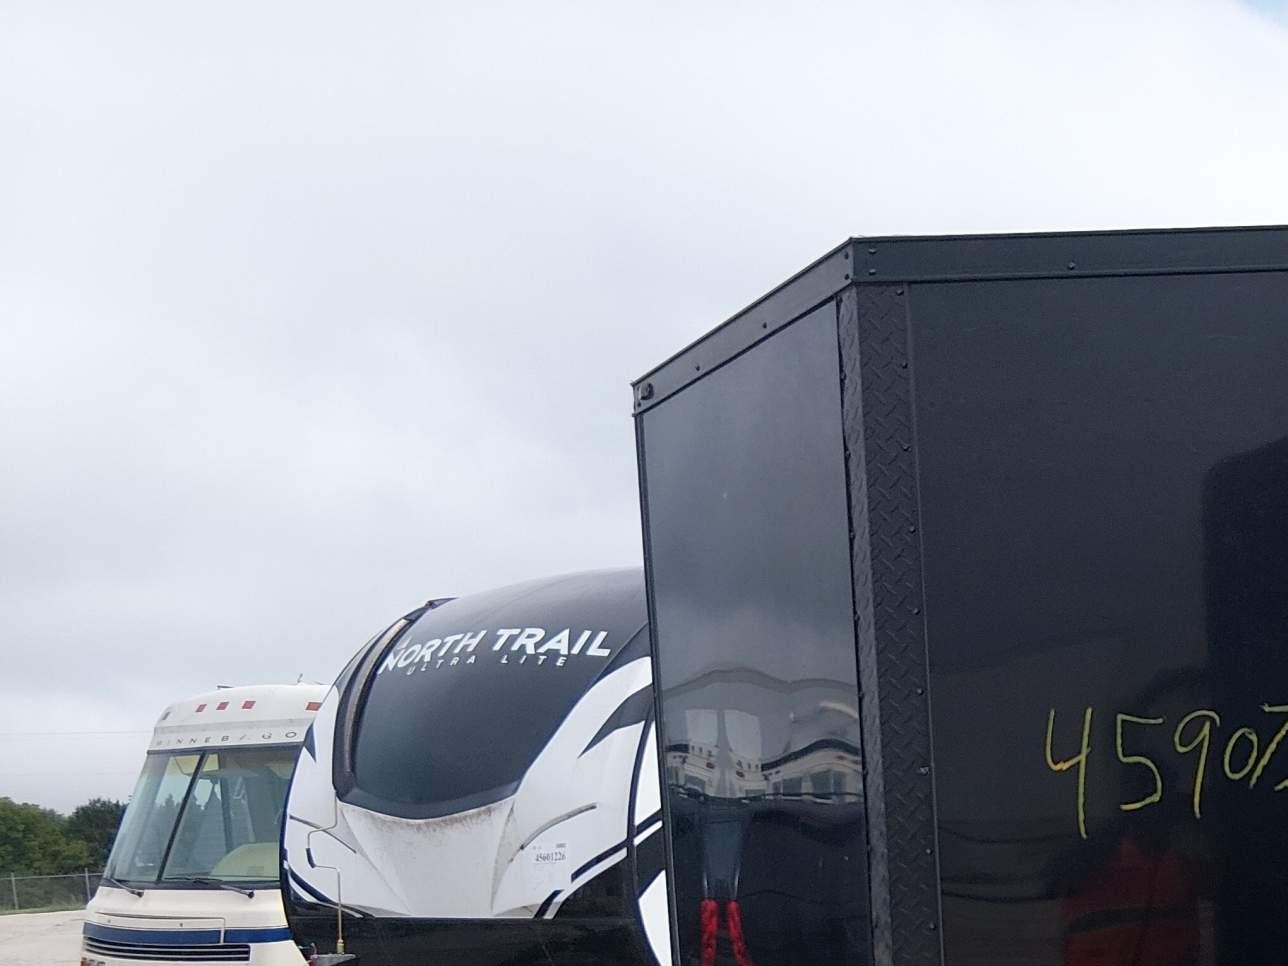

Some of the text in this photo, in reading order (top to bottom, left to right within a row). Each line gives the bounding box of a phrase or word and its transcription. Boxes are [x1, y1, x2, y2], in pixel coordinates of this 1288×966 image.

[377, 627, 612, 675] NORTH TRAIL
[407, 654, 568, 676] ULTRA LITE
